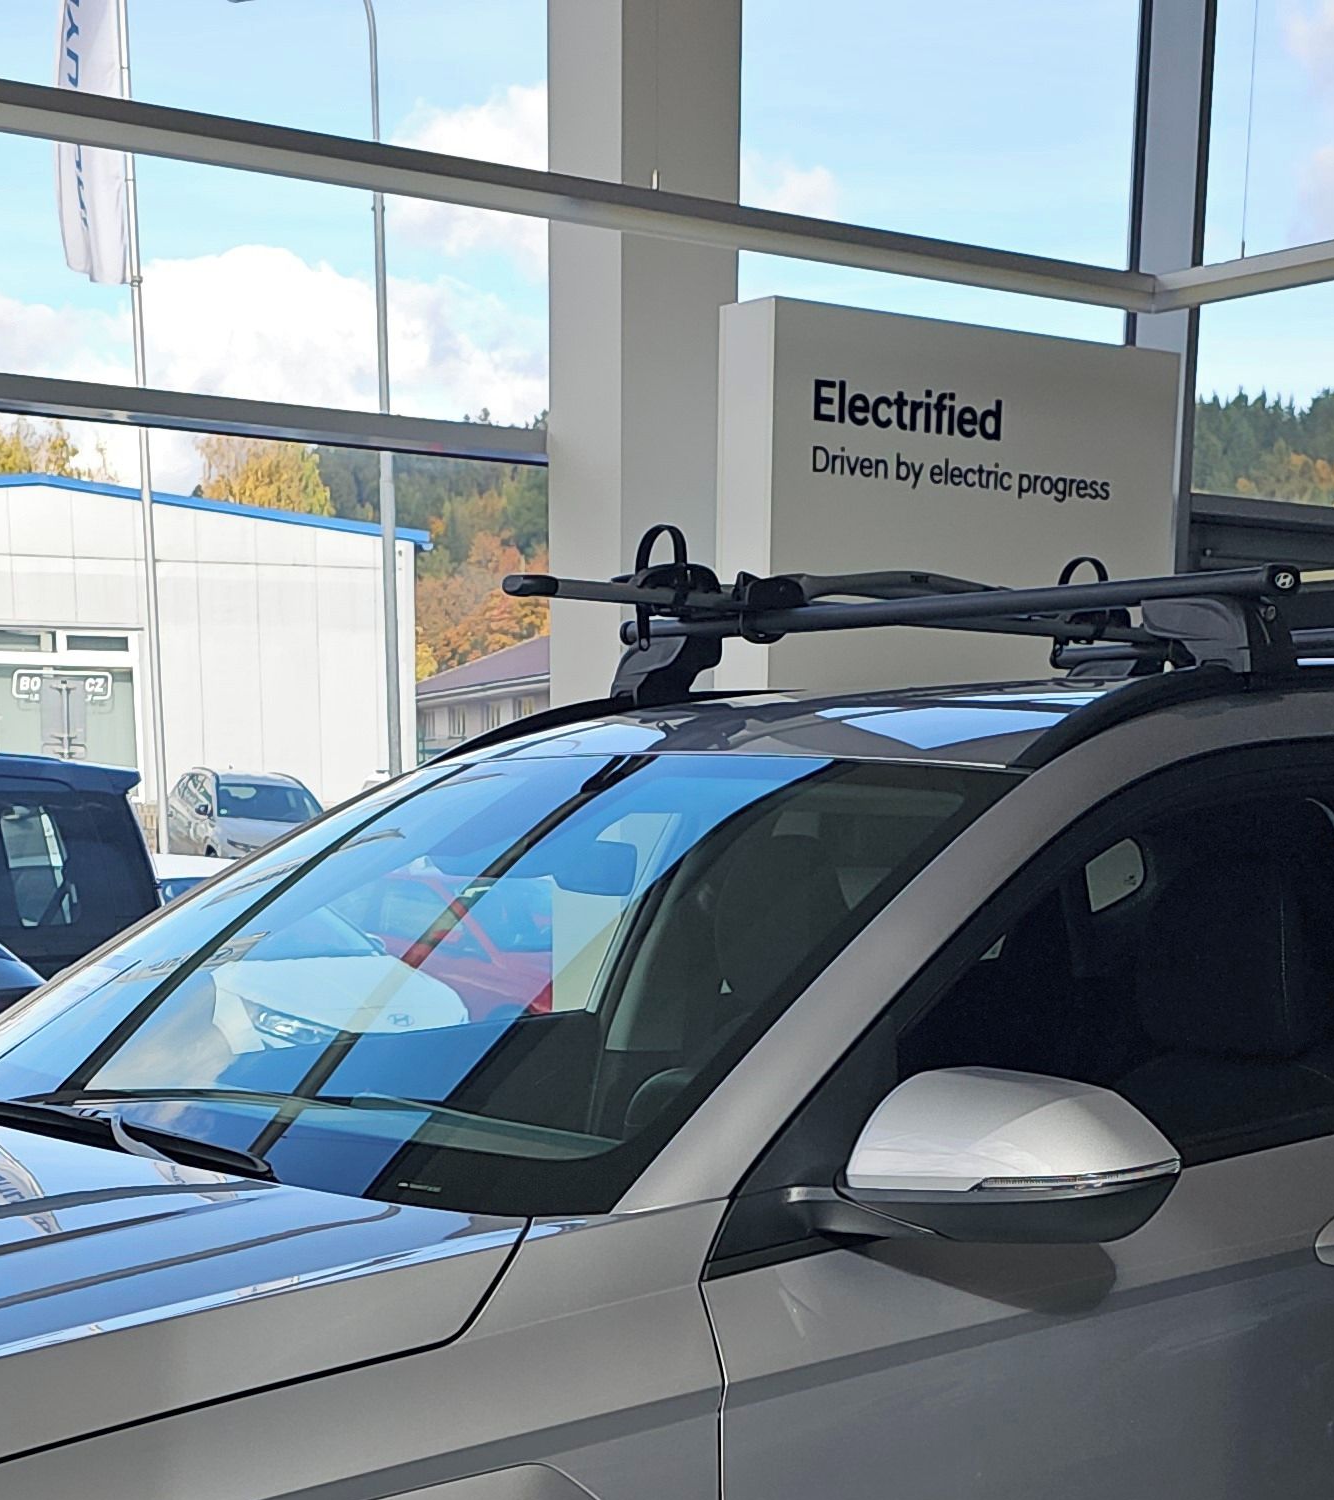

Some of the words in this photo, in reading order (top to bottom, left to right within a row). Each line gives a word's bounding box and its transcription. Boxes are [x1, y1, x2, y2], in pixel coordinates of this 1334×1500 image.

[813, 379, 1002, 441] Electrified
[812, 446, 888, 479] Driven
[895, 452, 924, 489] by
[929, 458, 1012, 491] electric
[1018, 472, 1110, 503] progress
